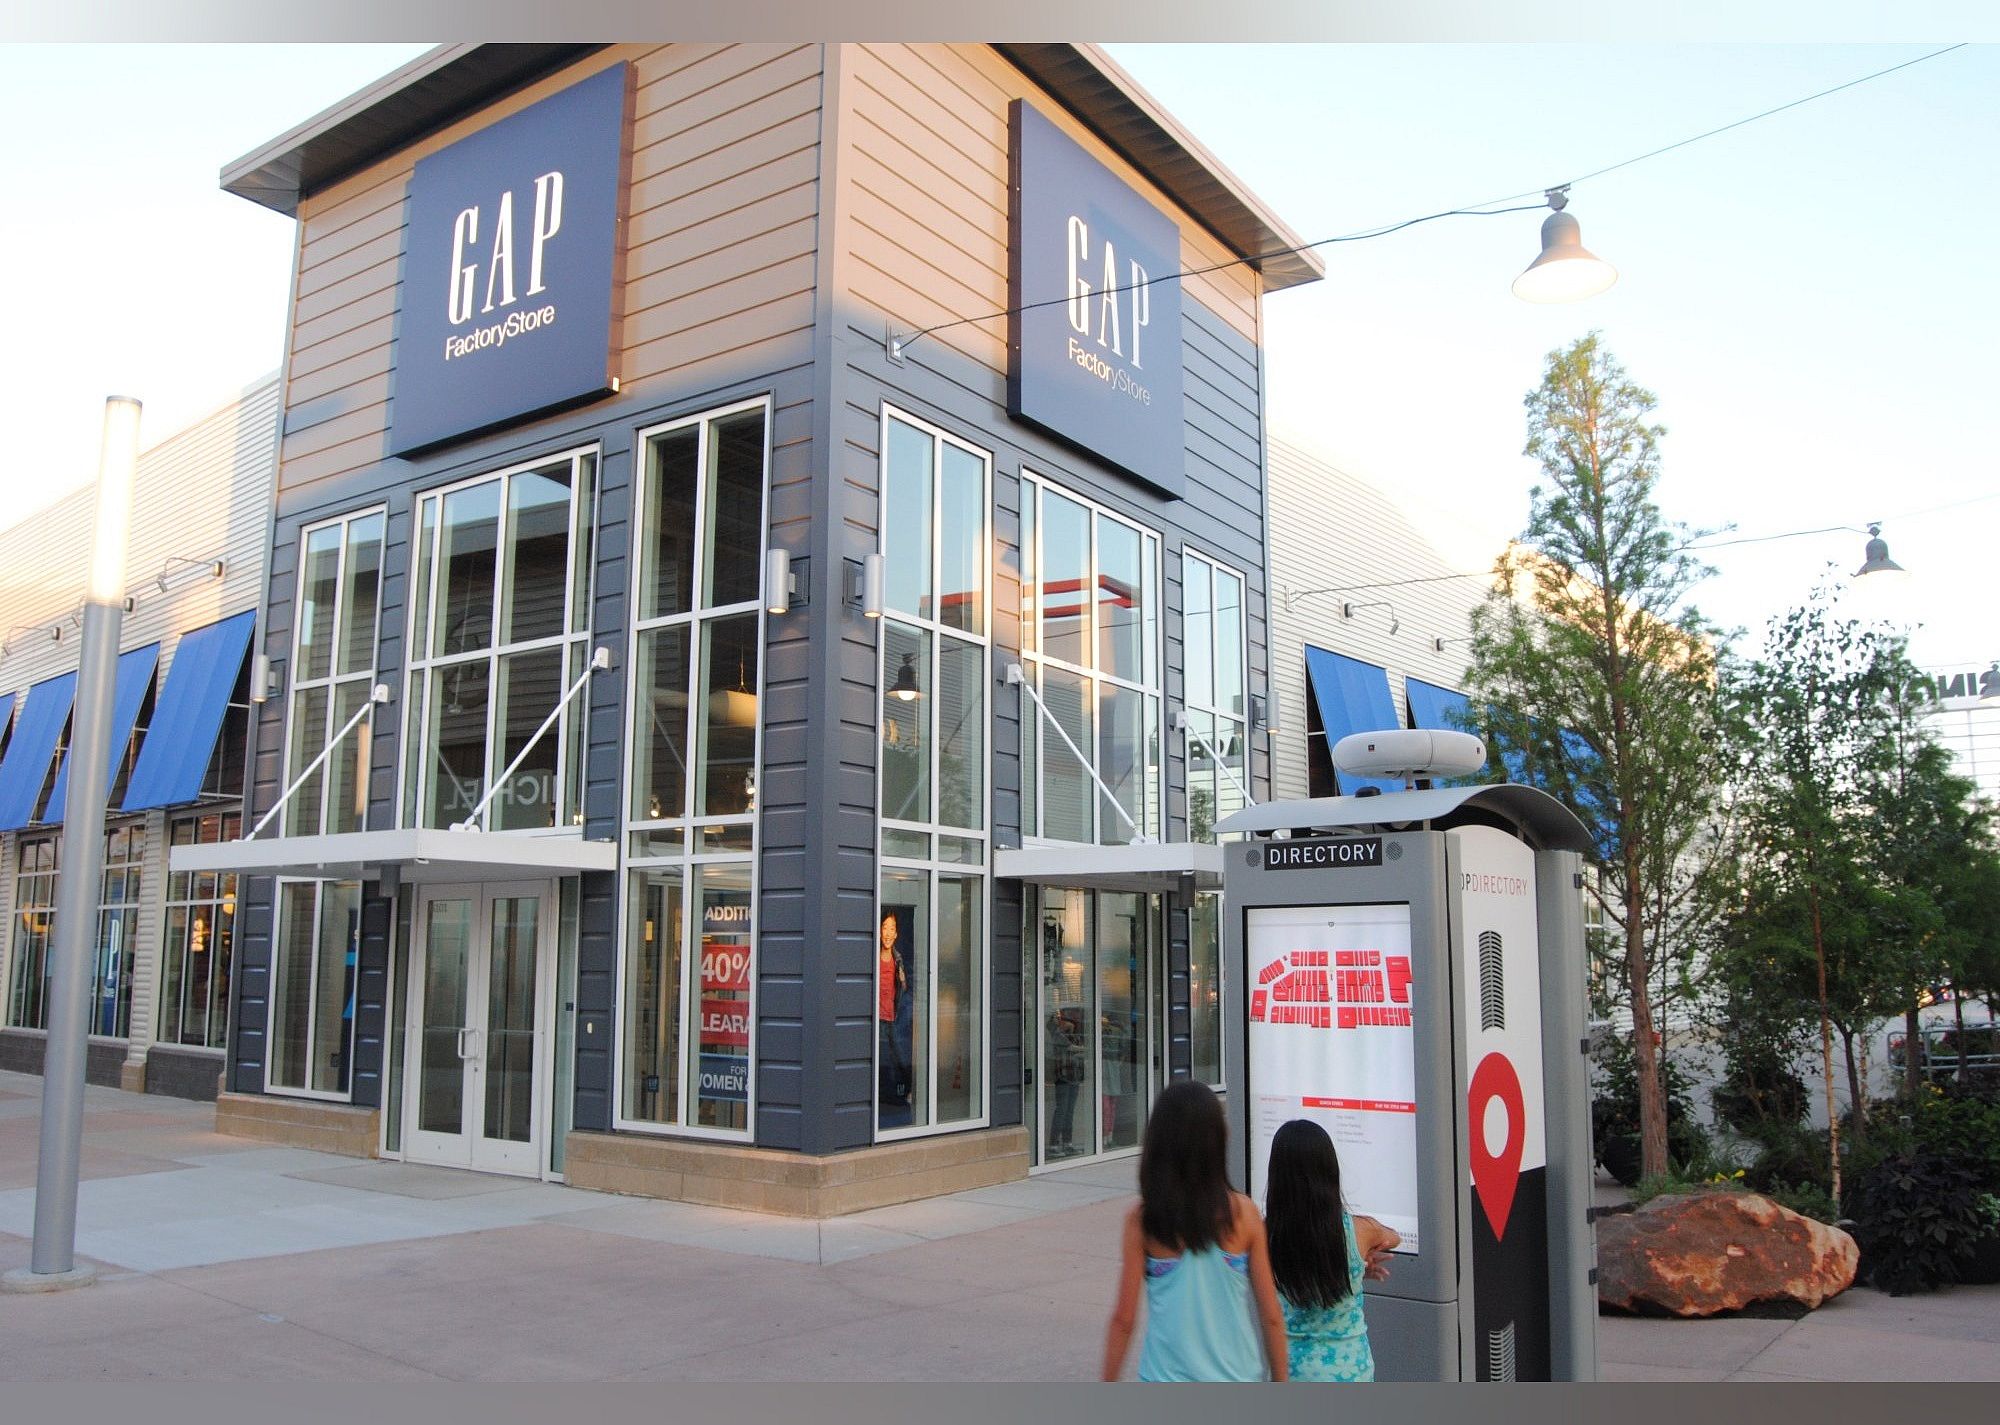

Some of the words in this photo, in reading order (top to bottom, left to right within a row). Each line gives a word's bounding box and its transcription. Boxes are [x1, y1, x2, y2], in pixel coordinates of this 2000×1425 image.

[448, 171, 564, 325] GAP
[1067, 215, 1149, 370] GAP
[445, 305, 555, 361] FactoryStore
[1068, 337, 1152, 406] FactoryStore
[1269, 843, 1377, 865] DIRECTORY
[704, 906, 752, 921] ADDITI
[701, 953, 751, 984] 40%
[700, 1012, 750, 1034] LEAR
